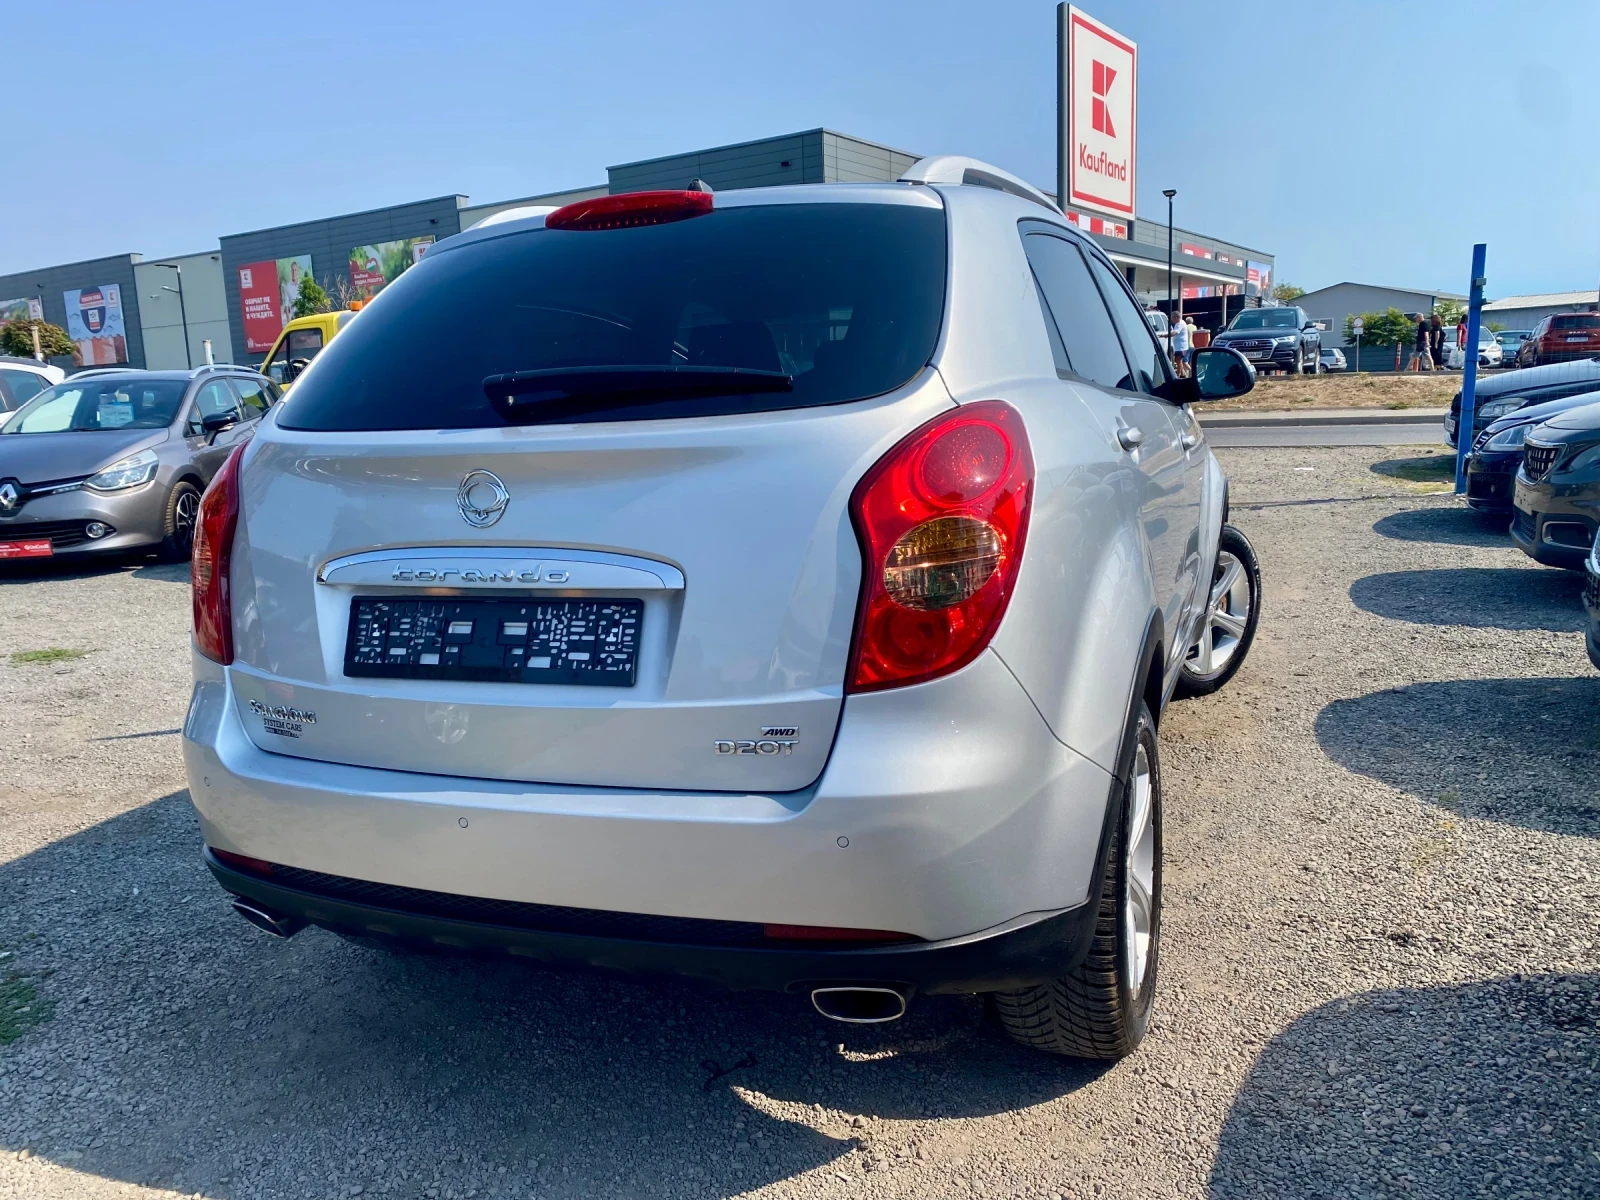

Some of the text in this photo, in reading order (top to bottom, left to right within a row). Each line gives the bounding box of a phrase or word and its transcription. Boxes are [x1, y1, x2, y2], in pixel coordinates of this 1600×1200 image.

[1079, 142, 1127, 182] Kaufland
[263, 718, 285, 730] SYSTEM
[286, 722, 303, 732] CARS
[763, 728, 795, 736] AWD
